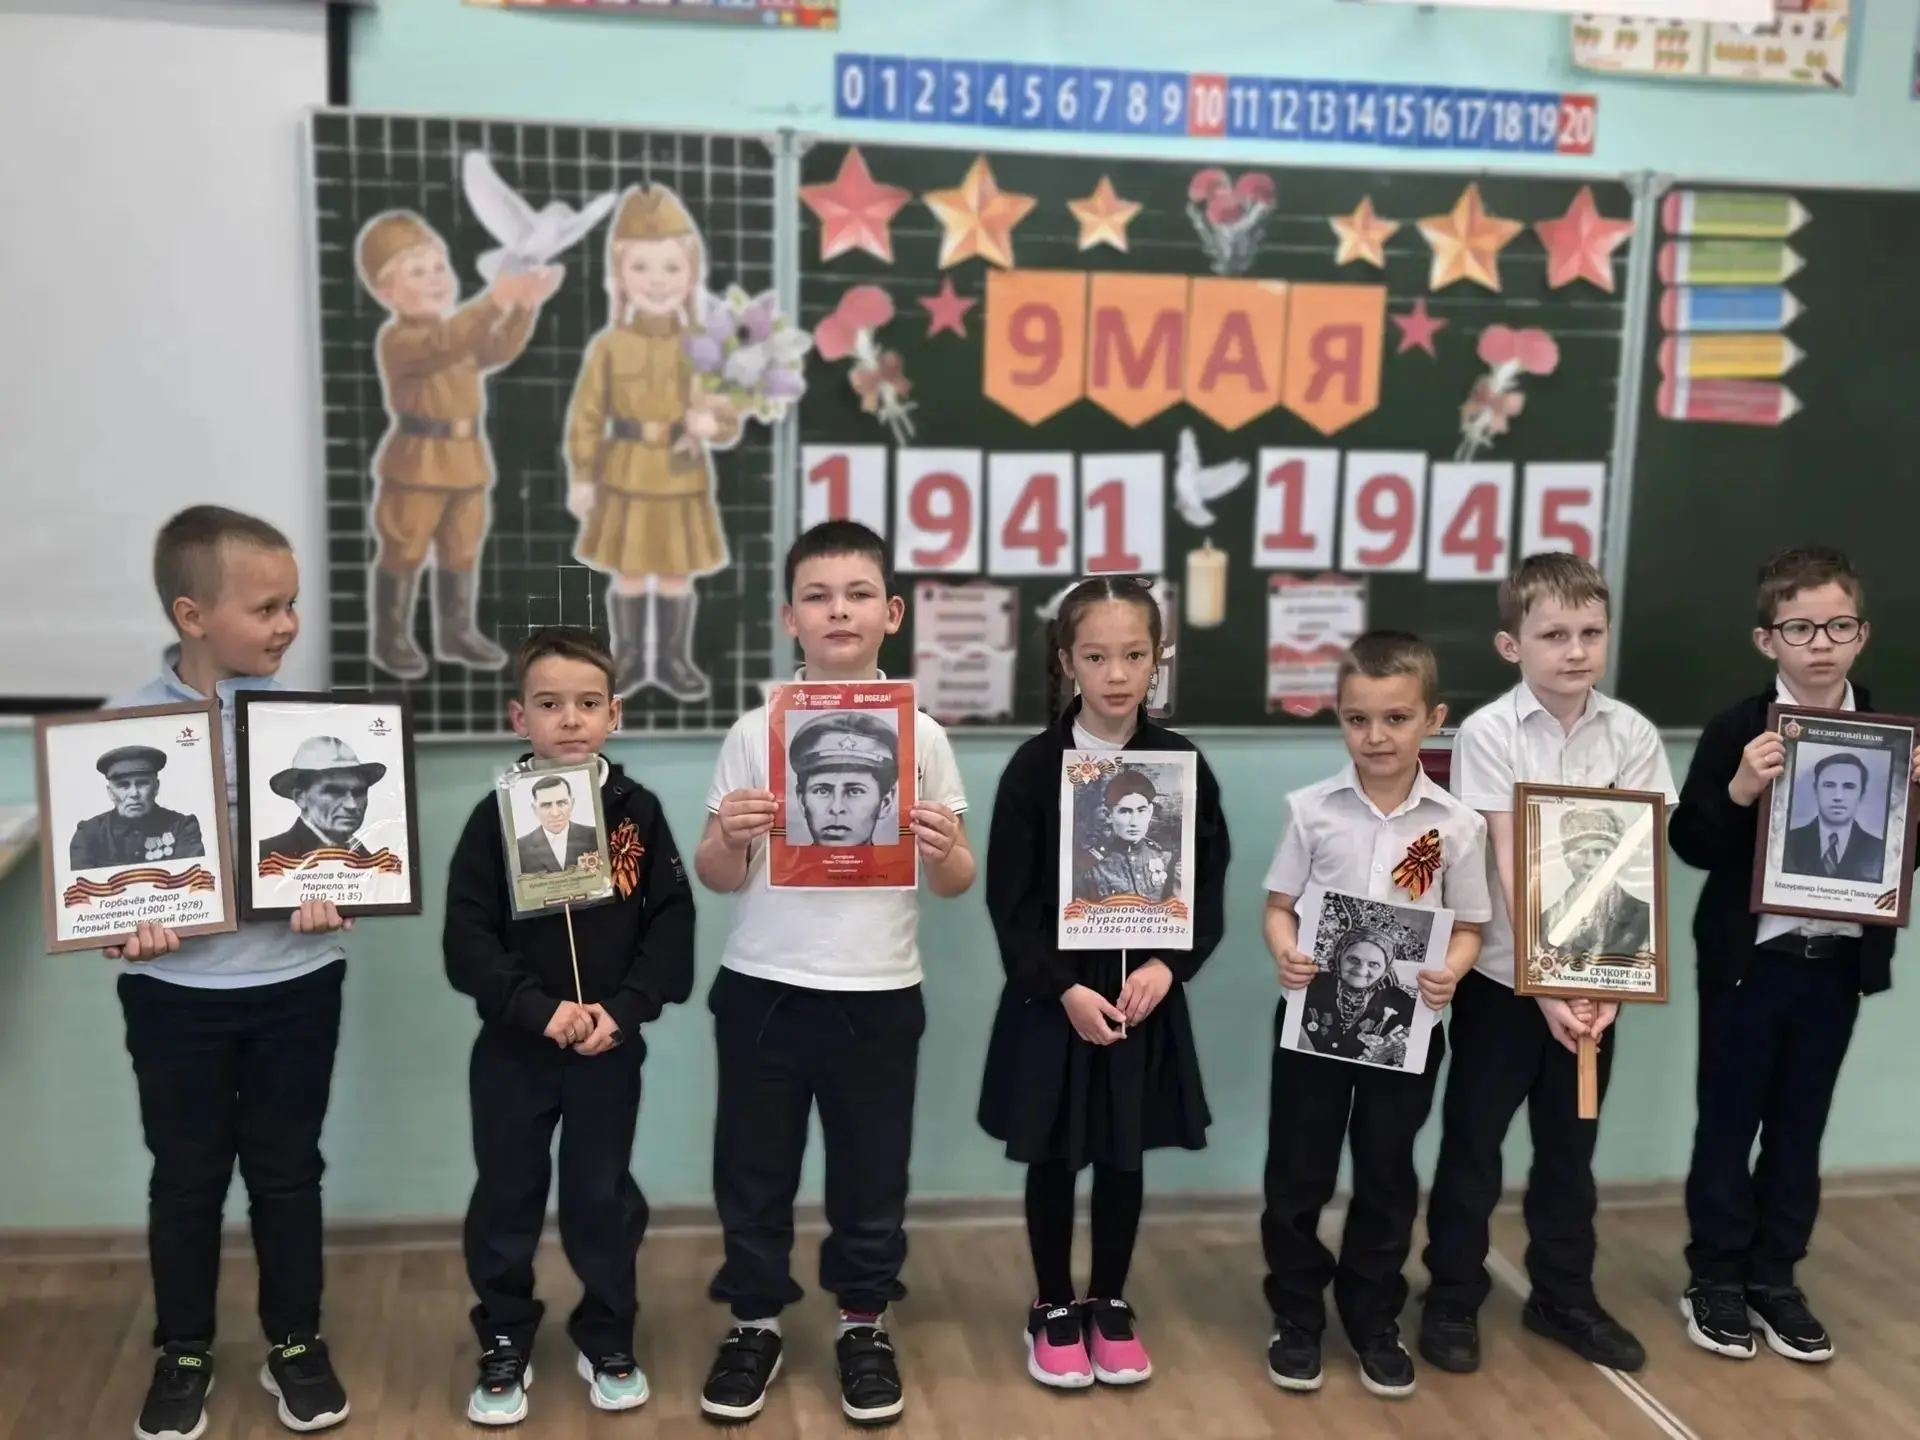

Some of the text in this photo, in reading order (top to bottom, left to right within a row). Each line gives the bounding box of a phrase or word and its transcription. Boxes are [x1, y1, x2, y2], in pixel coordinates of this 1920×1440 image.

[842, 66, 1594, 145] 0 1 2 3 4 5 6 7 8 9 10 11 12 13 14 15 16 17 18 19 20
[854, 694, 864, 703] 80
[1808, 728, 1861, 740] БЕССМЕРТНЫЙ
[292, 871, 334, 881] аркелов
[302, 882, 359, 892] Маркелоич
[100, 892, 180, 910] Горбачёв Федор
[77, 909, 135, 923] Алексеевич
[138, 904, 166, 918] (1900
[176, 900, 204, 912] 1978)
[72, 922, 111, 935] Первый
[178, 912, 210, 925] фронт
[1600, 976, 1651, 986] Афанасевич
